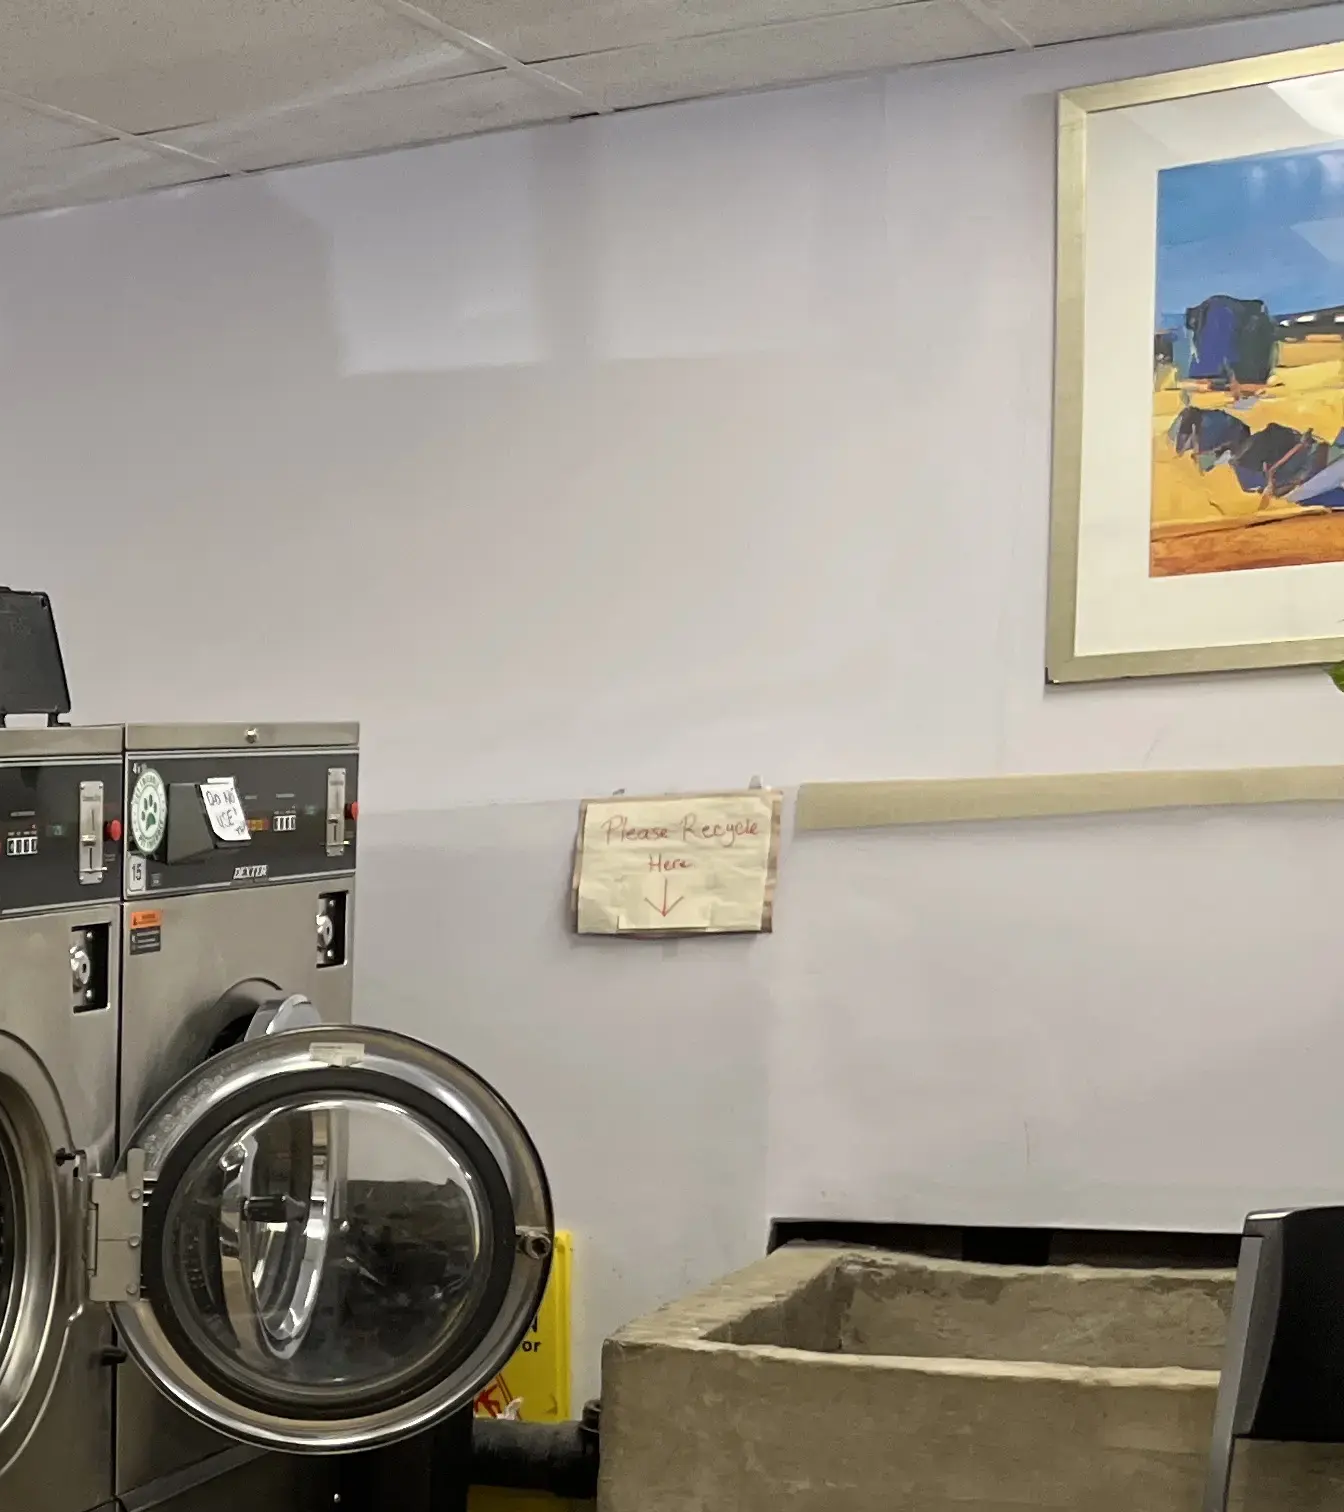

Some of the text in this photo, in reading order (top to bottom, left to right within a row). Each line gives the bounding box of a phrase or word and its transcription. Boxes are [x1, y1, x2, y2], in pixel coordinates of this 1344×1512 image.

[601, 812, 761, 848] Please Recycle
[648, 853, 693, 873] Here
